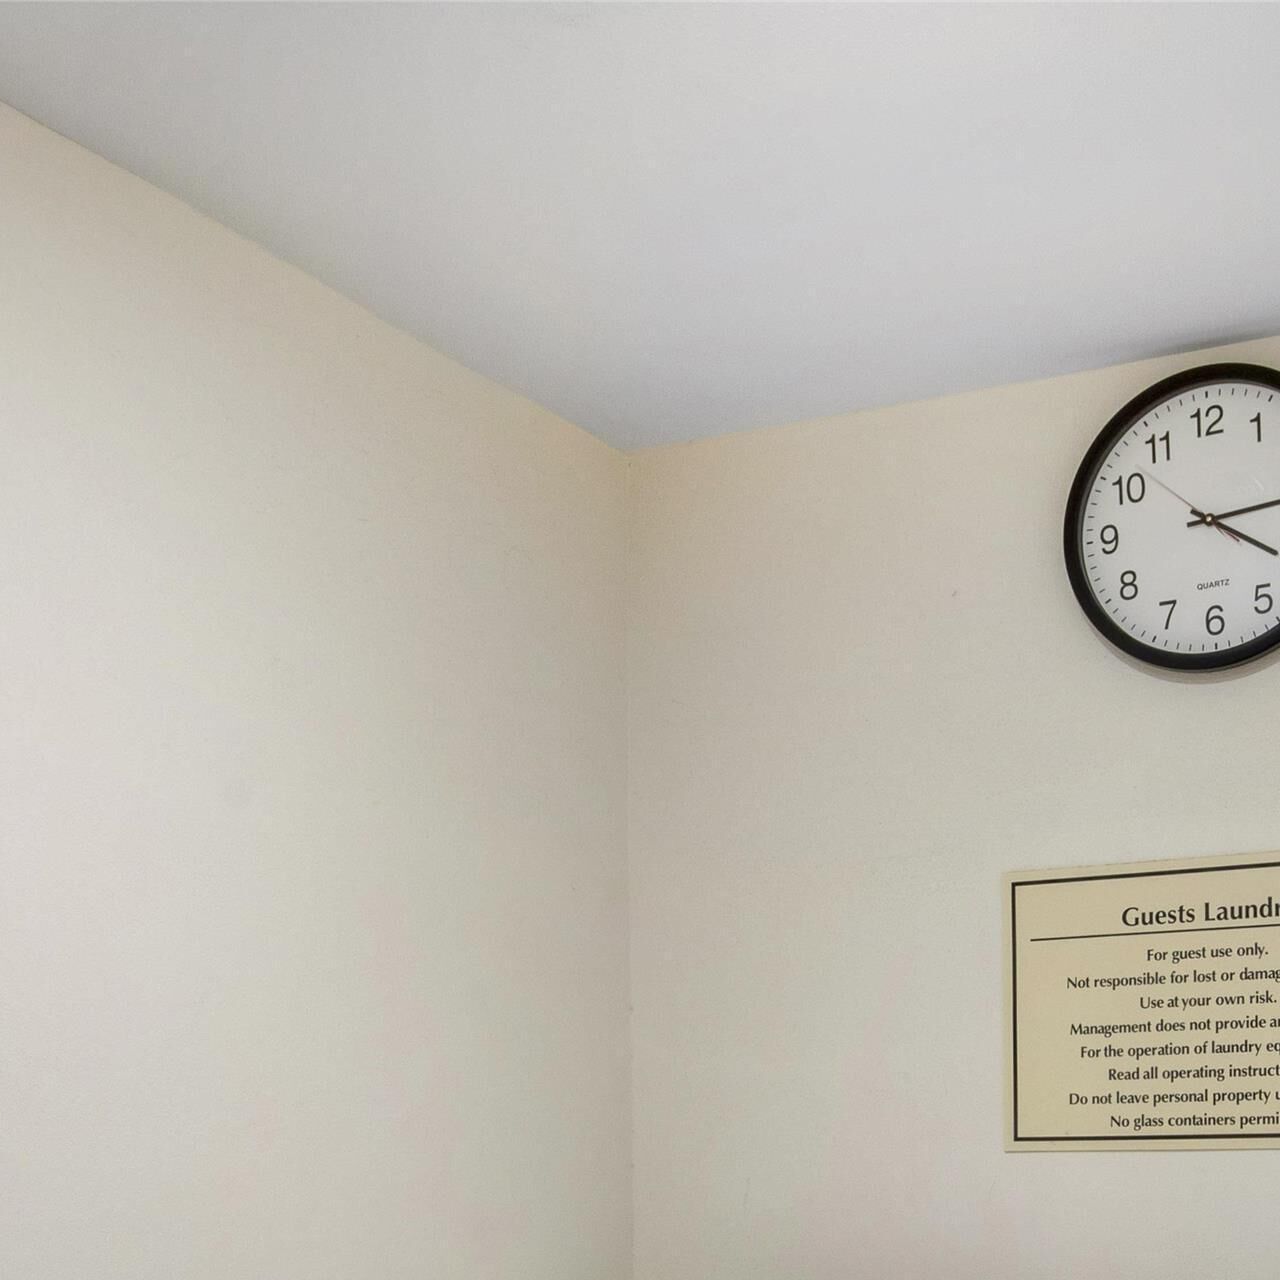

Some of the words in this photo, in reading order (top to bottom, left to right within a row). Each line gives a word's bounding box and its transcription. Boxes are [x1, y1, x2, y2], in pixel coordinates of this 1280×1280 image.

[1190, 404, 1225, 438] 12
[1249, 411, 1262, 442] 1
[1145, 430, 1171, 464] 11
[1112, 472, 1146, 505] 10
[1100, 524, 1119, 554] 9
[1119, 570, 1138, 600] 8
[1196, 578, 1230, 590] QUARTZ
[1253, 583, 1273, 614] 5
[1159, 599, 1177, 630] 7
[1205, 605, 1225, 635] 6
[1121, 905, 1195, 926] Guests
[1147, 949, 1168, 961] For
[1172, 947, 1206, 964] guest
[1211, 947, 1233, 958] use
[1237, 942, 1269, 959] only.
[1067, 977, 1090, 989] Not
[1094, 972, 1166, 991] responsible
[1170, 971, 1189, 984] for
[1193, 970, 1216, 983] lost
[1220, 971, 1235, 982] or
[1140, 997, 1164, 1009] Use
[1167, 996, 1179, 1008] at
[1181, 997, 1211, 1011] your
[1216, 995, 1245, 1005] own
[1249, 990, 1277, 1004] risk.
[1070, 1021, 1151, 1038] Management
[1155, 1019, 1185, 1032] does
[1189, 1019, 1211, 1030] not
[1215, 1015, 1266, 1034] provide
[1080, 1046, 1101, 1058] For
[1104, 1044, 1124, 1057] the
[1128, 1042, 1190, 1060] operation
[1194, 1041, 1208, 1054] of
[1211, 1039, 1262, 1056] laundry
[1108, 1067, 1139, 1081] Read
[1143, 1066, 1158, 1079] all
[1162, 1065, 1225, 1083] operating
[1069, 1093, 1088, 1105] Do
[1091, 1093, 1112, 1104] not
[1116, 1091, 1149, 1104] leave
[1153, 1089, 1208, 1107] personal
[1213, 1089, 1271, 1106] property
[1110, 1115, 1129, 1128] No
[1133, 1114, 1164, 1131] glass
[1168, 1112, 1236, 1127] containers
